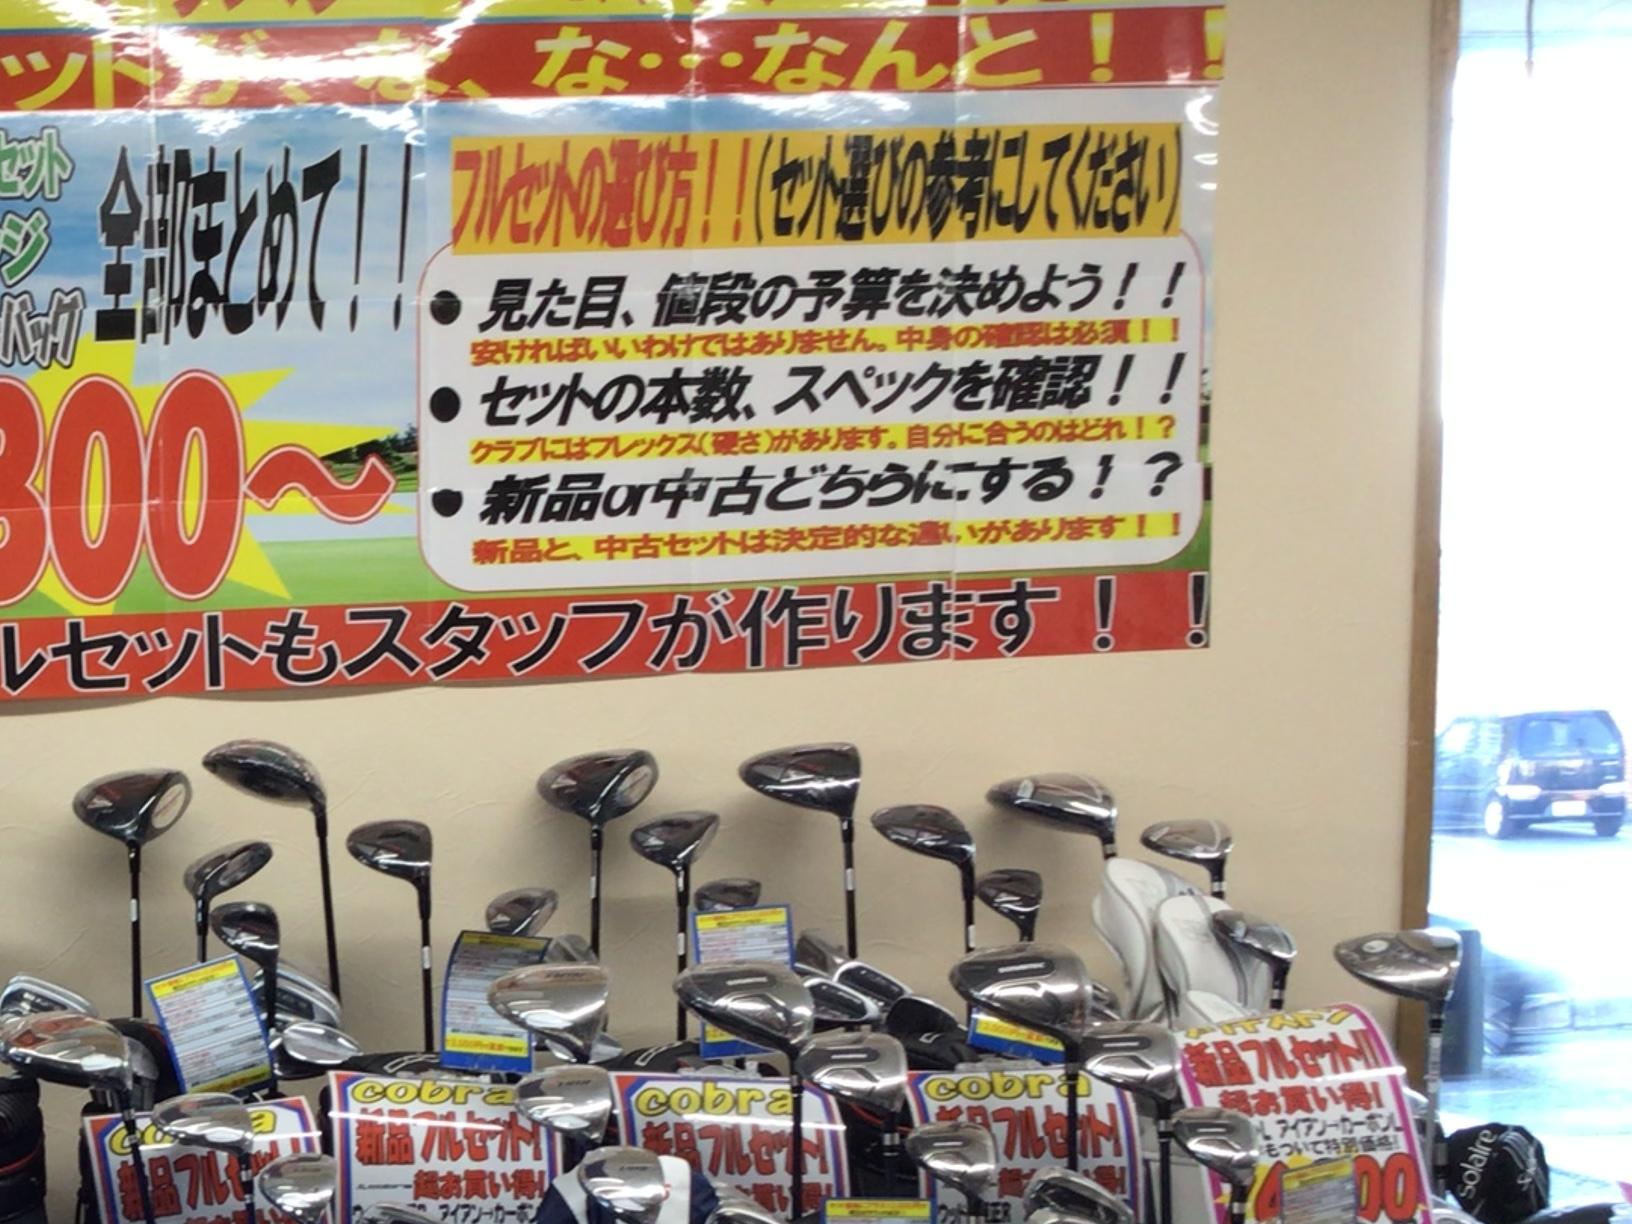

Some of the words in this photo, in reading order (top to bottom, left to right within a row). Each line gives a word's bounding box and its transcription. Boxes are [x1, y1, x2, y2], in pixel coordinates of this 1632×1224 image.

[351, 1080, 515, 1106] cobra
[634, 1080, 795, 1117] cobra
[924, 1071, 1092, 1101] cobra
